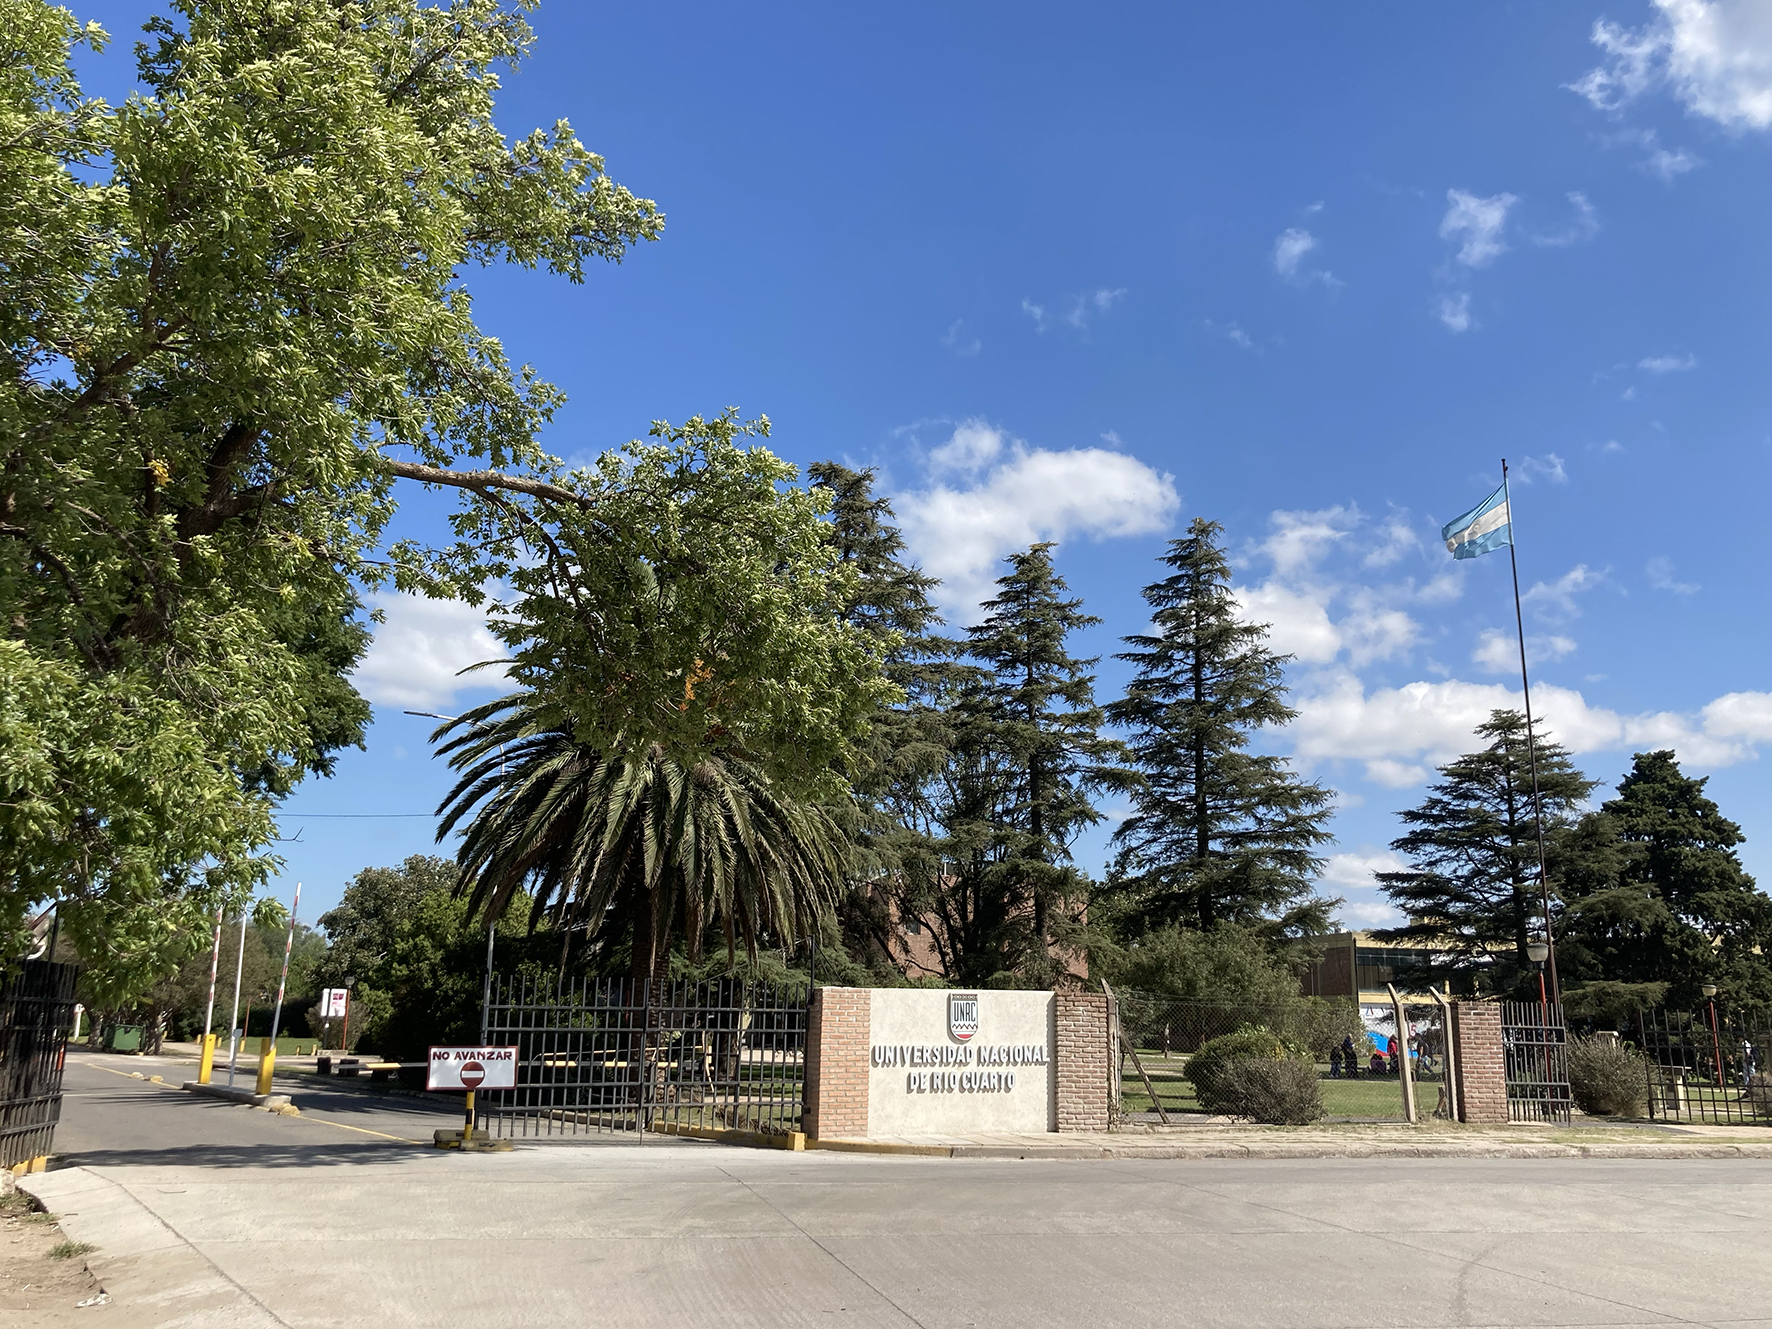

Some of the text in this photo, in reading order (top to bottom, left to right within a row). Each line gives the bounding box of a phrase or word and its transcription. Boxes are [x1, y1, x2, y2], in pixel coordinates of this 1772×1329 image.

[953, 1002, 976, 1022] UNRC
[432, 1051, 512, 1060] NO AVANZAR
[872, 1045, 1050, 1065] UNIVERSIDAD NACIONAL
[909, 1071, 1017, 1091] DE RIO CUARTO
